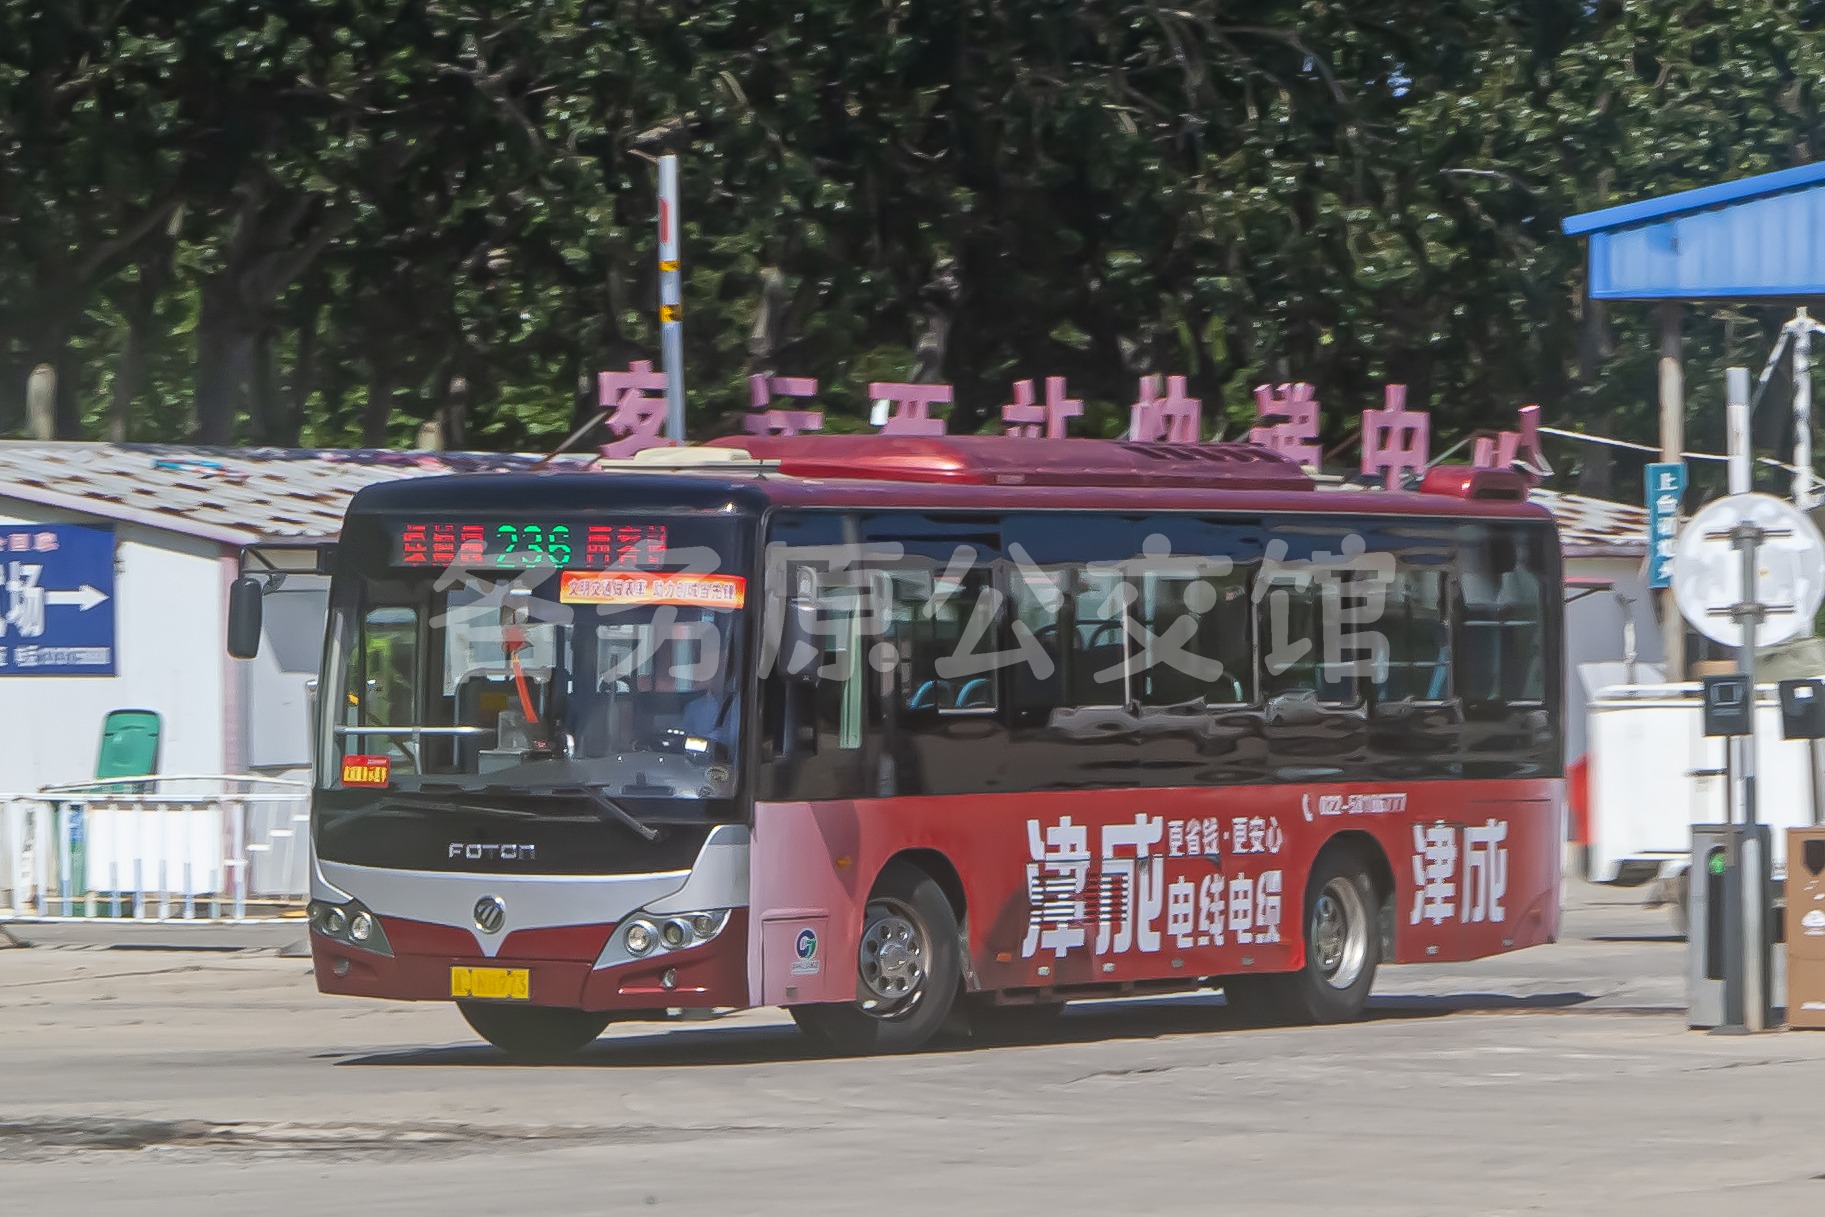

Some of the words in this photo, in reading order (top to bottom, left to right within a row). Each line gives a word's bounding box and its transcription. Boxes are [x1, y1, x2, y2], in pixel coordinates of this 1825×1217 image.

[496, 525, 572, 568] 236
[449, 843, 535, 860] FOTON
[1022, 813, 1163, 957] 津成
[1410, 818, 1508, 926] 津成
[1167, 872, 1282, 949] 电线电缆
